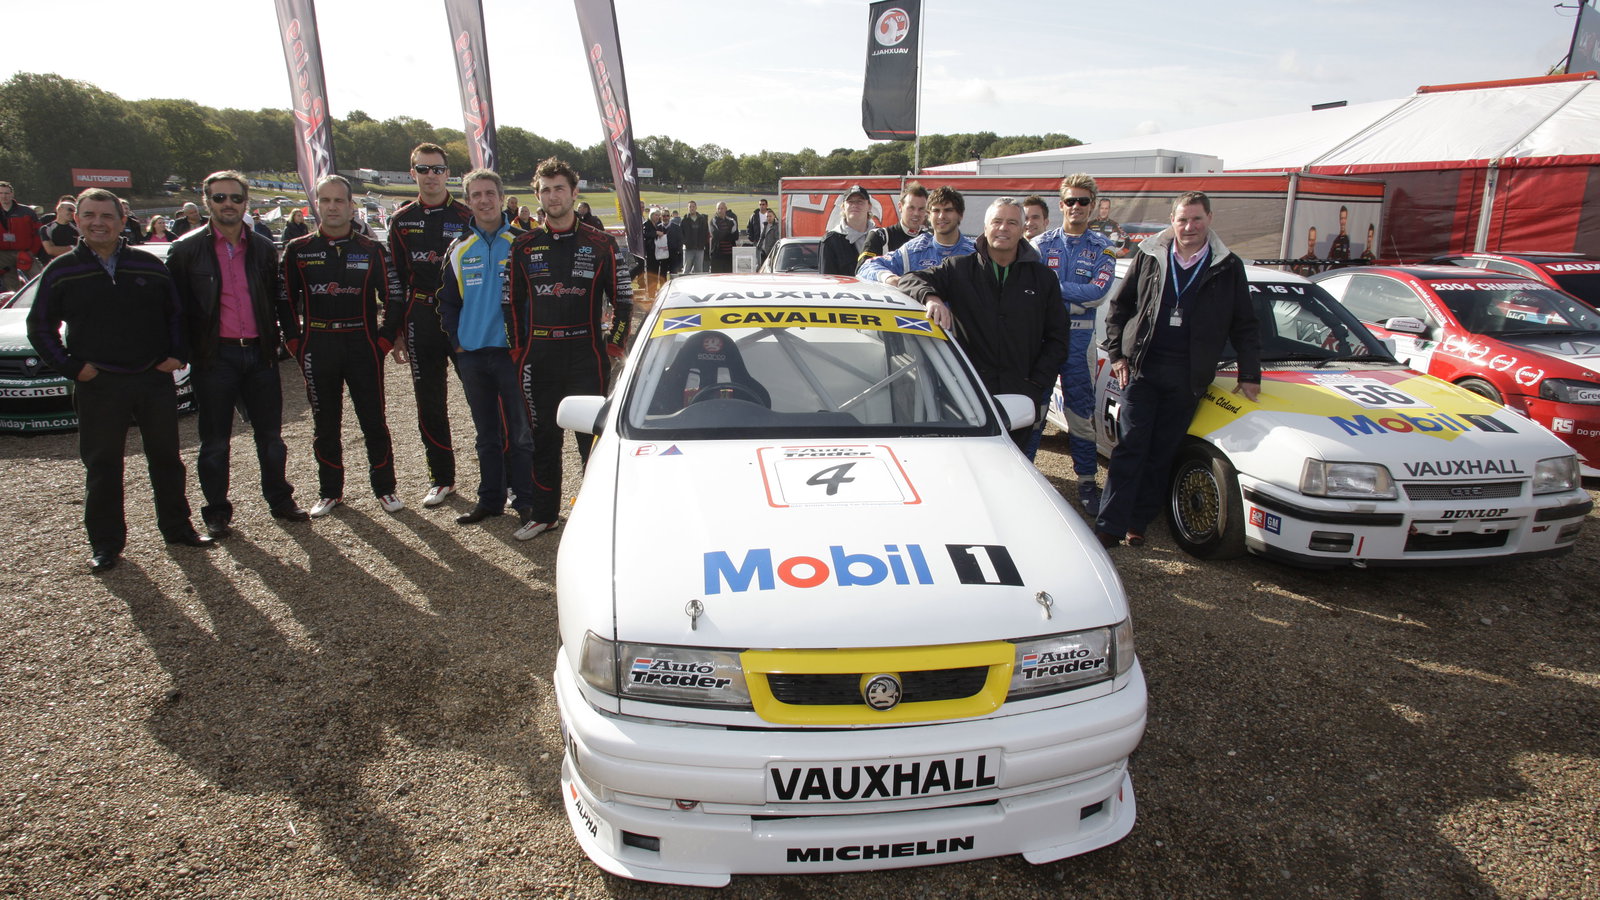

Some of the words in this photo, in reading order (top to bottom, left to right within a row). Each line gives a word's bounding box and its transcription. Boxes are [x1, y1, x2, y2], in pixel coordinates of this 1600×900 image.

[309, 282, 361, 296] VXRacing
[534, 282, 586, 298] VXRacing
[1267, 285, 1288, 294] 16
[1290, 286, 1305, 295] V
[1431, 283, 1475, 291] 2004
[688, 291, 906, 305] VAUXHALL
[720, 312, 882, 326] CAVALIER
[304, 352, 320, 415] VAUXHALL
[523, 364, 538, 429] VAUXHALL
[1334, 385, 1415, 405] 56
[1215, 397, 1241, 414] Cleland
[1329, 412, 1471, 436] Mobil
[1553, 418, 1573, 432] RS
[1577, 428, 1589, 436] Do
[1404, 460, 1524, 477] VAUXHALL
[806, 462, 857, 496] 4
[1267, 516, 1279, 528] GM
[1441, 508, 1509, 519] DUNLOP
[703, 544, 934, 595] Mobil
[1038, 649, 1090, 664] Auto
[650, 660, 714, 673] Auto
[1022, 658, 1104, 680] Trader
[631, 671, 731, 688] Trader
[770, 755, 996, 801] VAUXHALL
[575, 800, 598, 838] ALPHA
[786, 836, 975, 863] MICHELIN
